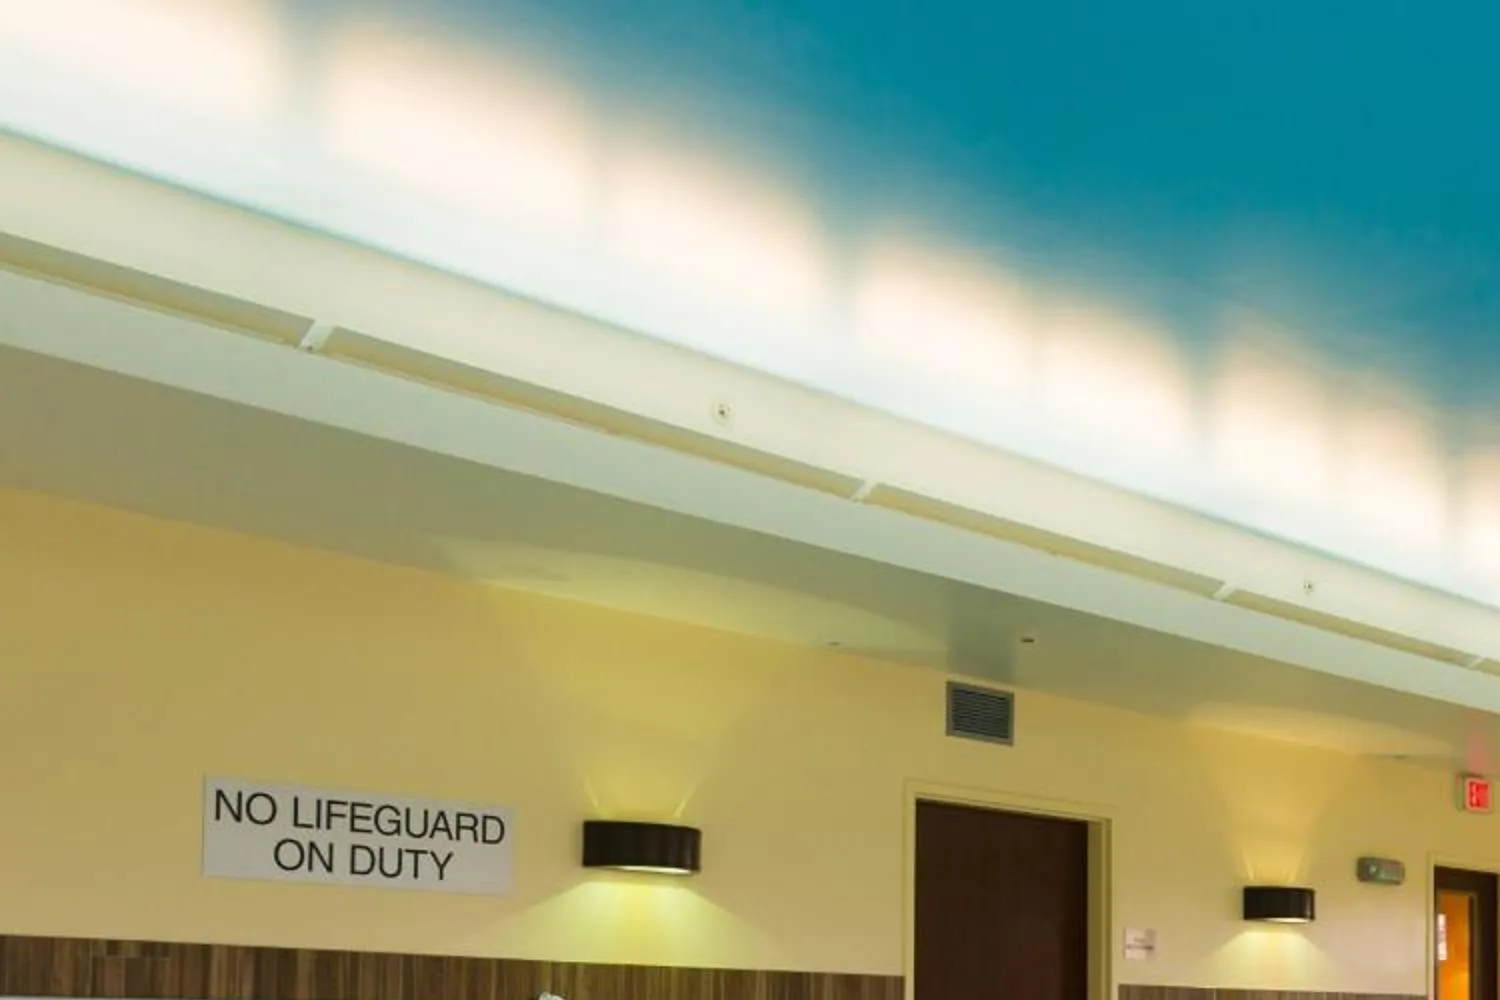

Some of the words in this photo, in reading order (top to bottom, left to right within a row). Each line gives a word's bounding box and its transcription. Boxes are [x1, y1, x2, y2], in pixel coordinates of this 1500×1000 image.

[214, 789, 277, 825] NO
[292, 796, 506, 845] LIFEGUARD
[273, 838, 334, 873] ON
[350, 844, 454, 881] DUTY
